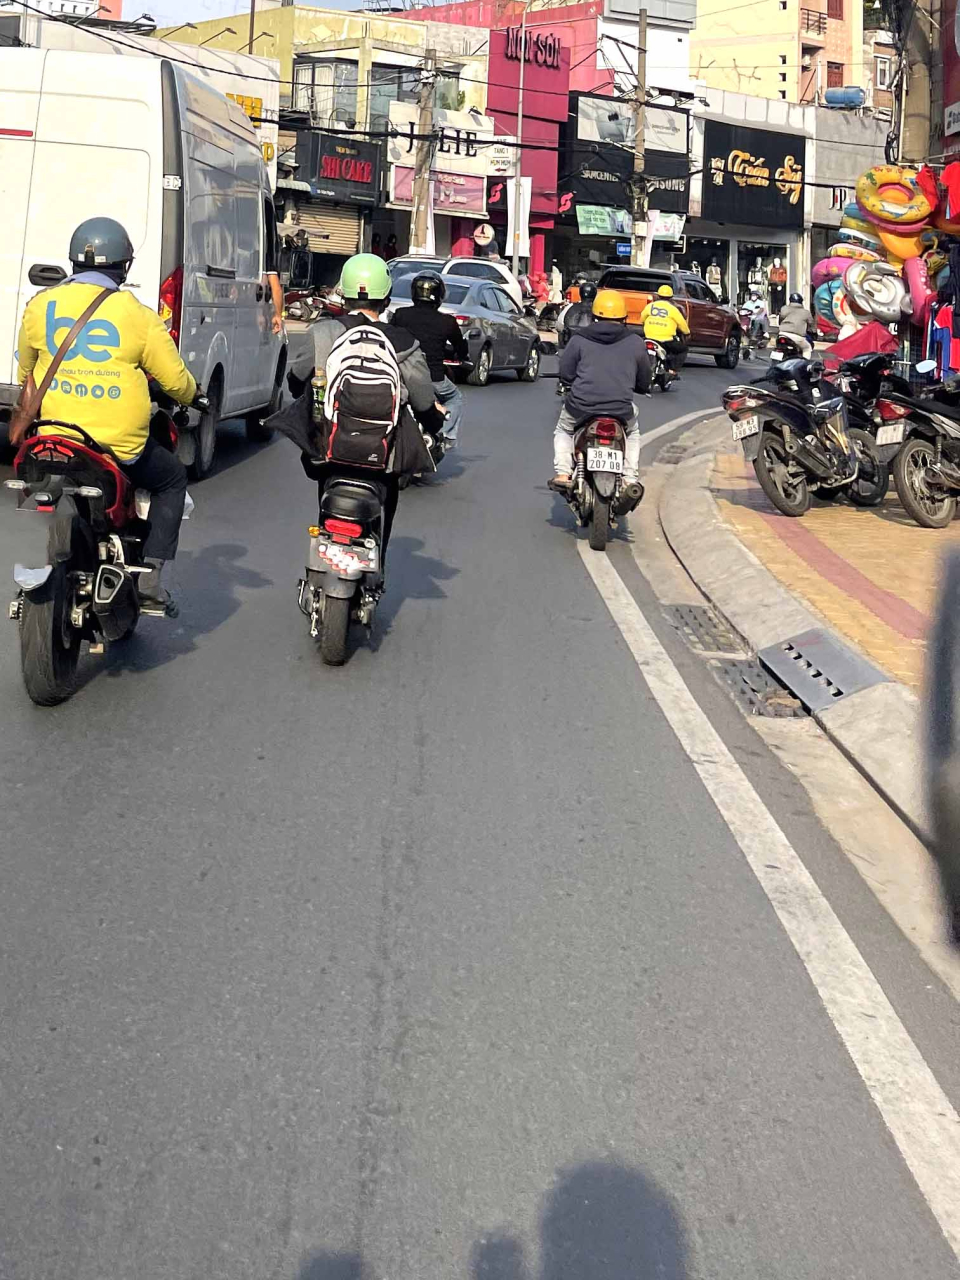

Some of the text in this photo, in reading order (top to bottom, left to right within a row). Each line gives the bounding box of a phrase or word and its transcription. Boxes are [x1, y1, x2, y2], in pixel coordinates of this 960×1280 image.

[406, 121, 477, 157] JLIE
[651, 304, 668, 318] be
[46, 300, 120, 363] be
